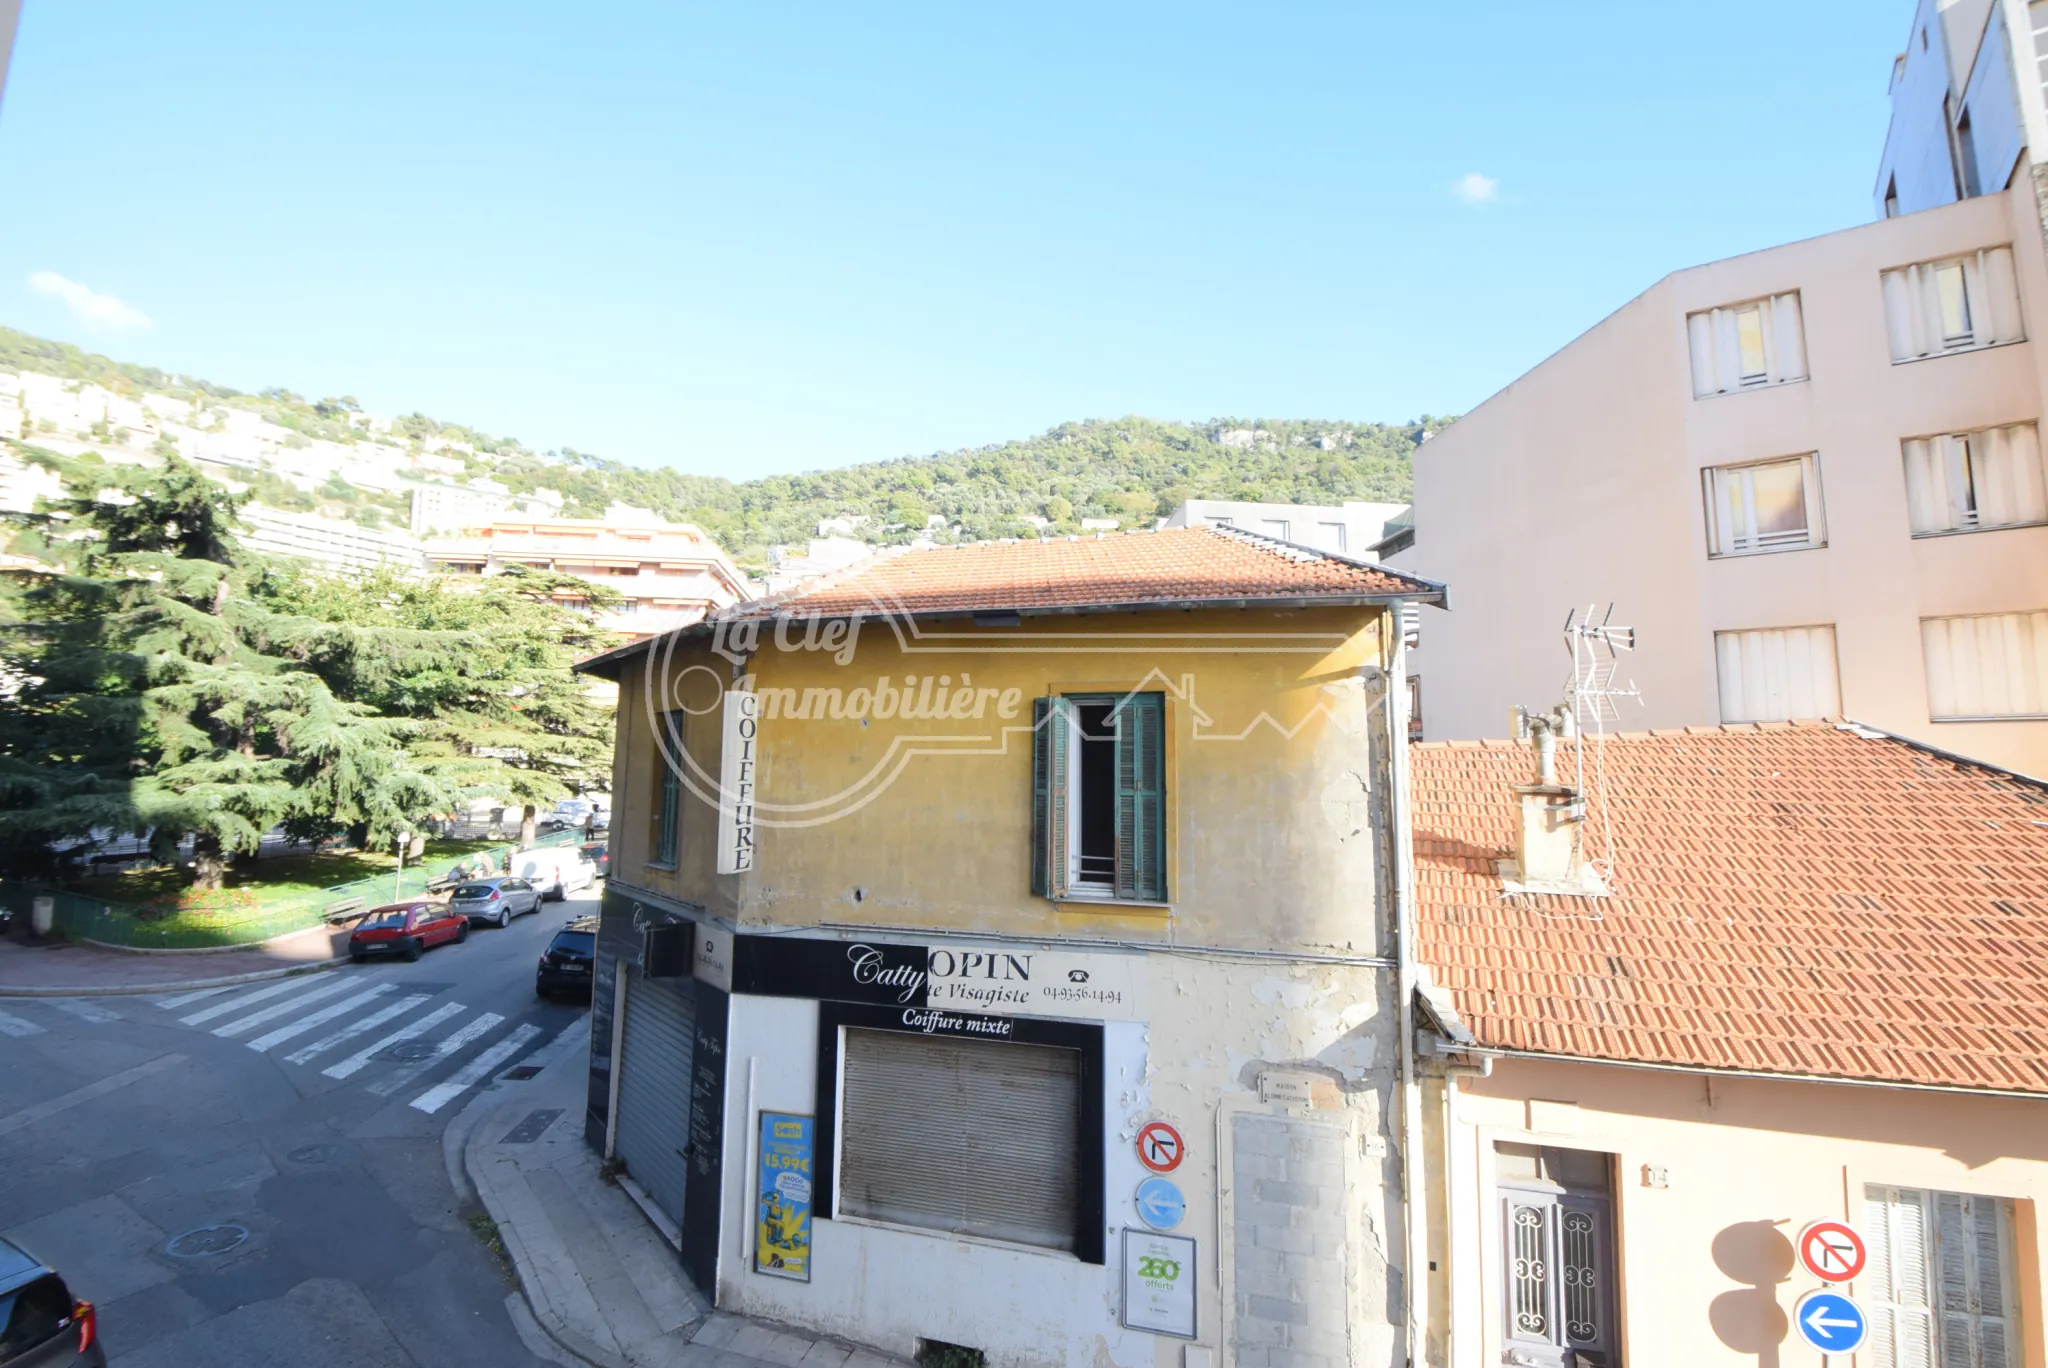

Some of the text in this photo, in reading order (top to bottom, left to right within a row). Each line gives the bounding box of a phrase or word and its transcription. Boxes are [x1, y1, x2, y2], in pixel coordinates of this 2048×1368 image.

[733, 696, 756, 871] COIFFURE
[847, 944, 927, 1003] Catty
[928, 950, 1033, 981] OPIN
[949, 984, 1030, 1008] Visagiste
[902, 1008, 1010, 1035] Coiffure mixte
[1144, 1280, 1174, 1292] offerts
